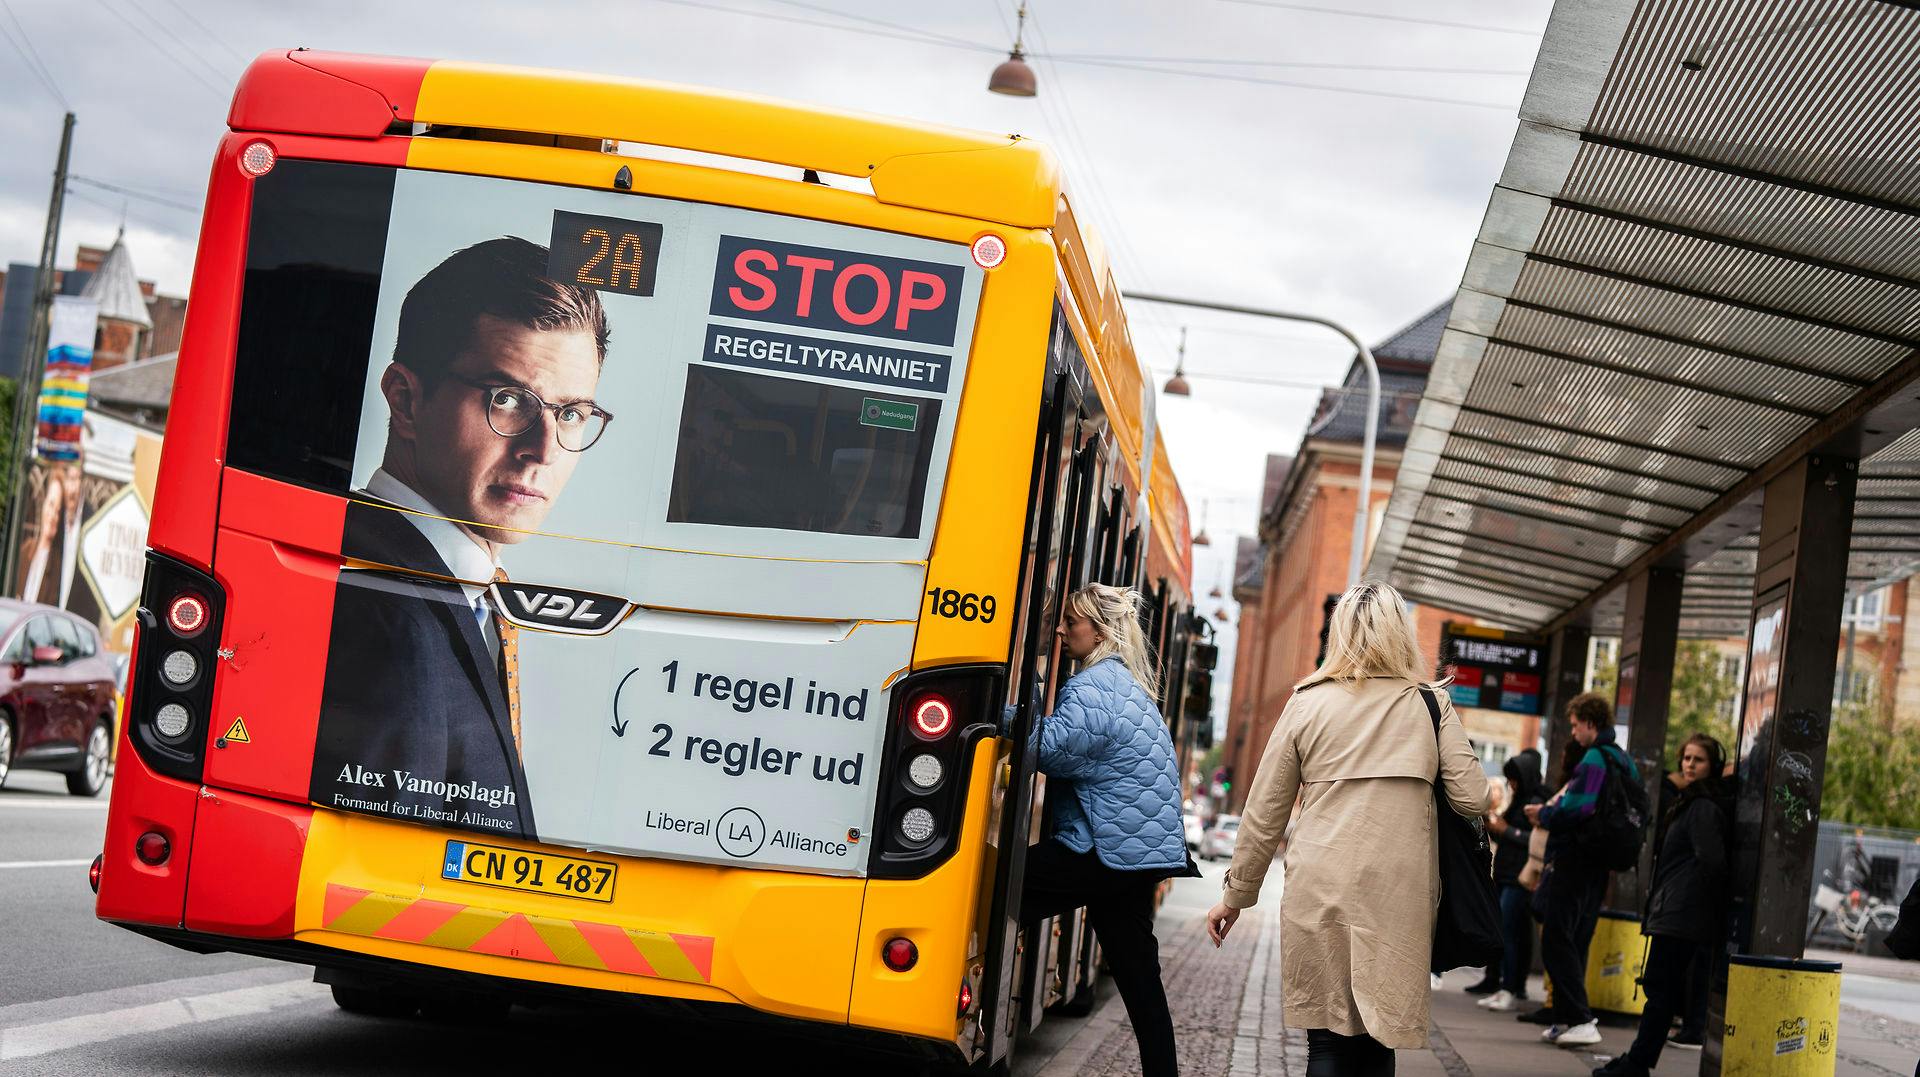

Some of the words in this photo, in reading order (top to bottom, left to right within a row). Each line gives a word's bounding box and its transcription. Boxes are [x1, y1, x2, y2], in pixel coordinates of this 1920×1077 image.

[577, 228, 643, 289] 2A
[728, 249, 947, 331] STOP
[714, 334, 942, 383] REGELTYRANNIET
[513, 589, 602, 622] VDL
[927, 587, 997, 624] 1869
[662, 660, 679, 693] 1
[693, 672, 794, 713] regel
[805, 680, 869, 721] ind
[648, 723, 673, 757] 2
[684, 736, 803, 777] regler
[812, 753, 864, 786] ud
[337, 763, 387, 788] Alex
[393, 769, 516, 809] Vanopslagh
[333, 793, 389, 813] Formand
[392, 801, 411, 816] for
[414, 804, 458, 822] Liberal
[461, 812, 513, 830] Alliance
[645, 810, 711, 836] Liberal
[728, 822, 753, 842] LA
[770, 829, 848, 856] Alliance
[446, 863, 459, 873] DK
[466, 850, 506, 880] CN
[513, 856, 543, 887] 91
[556, 863, 612, 895] 487
